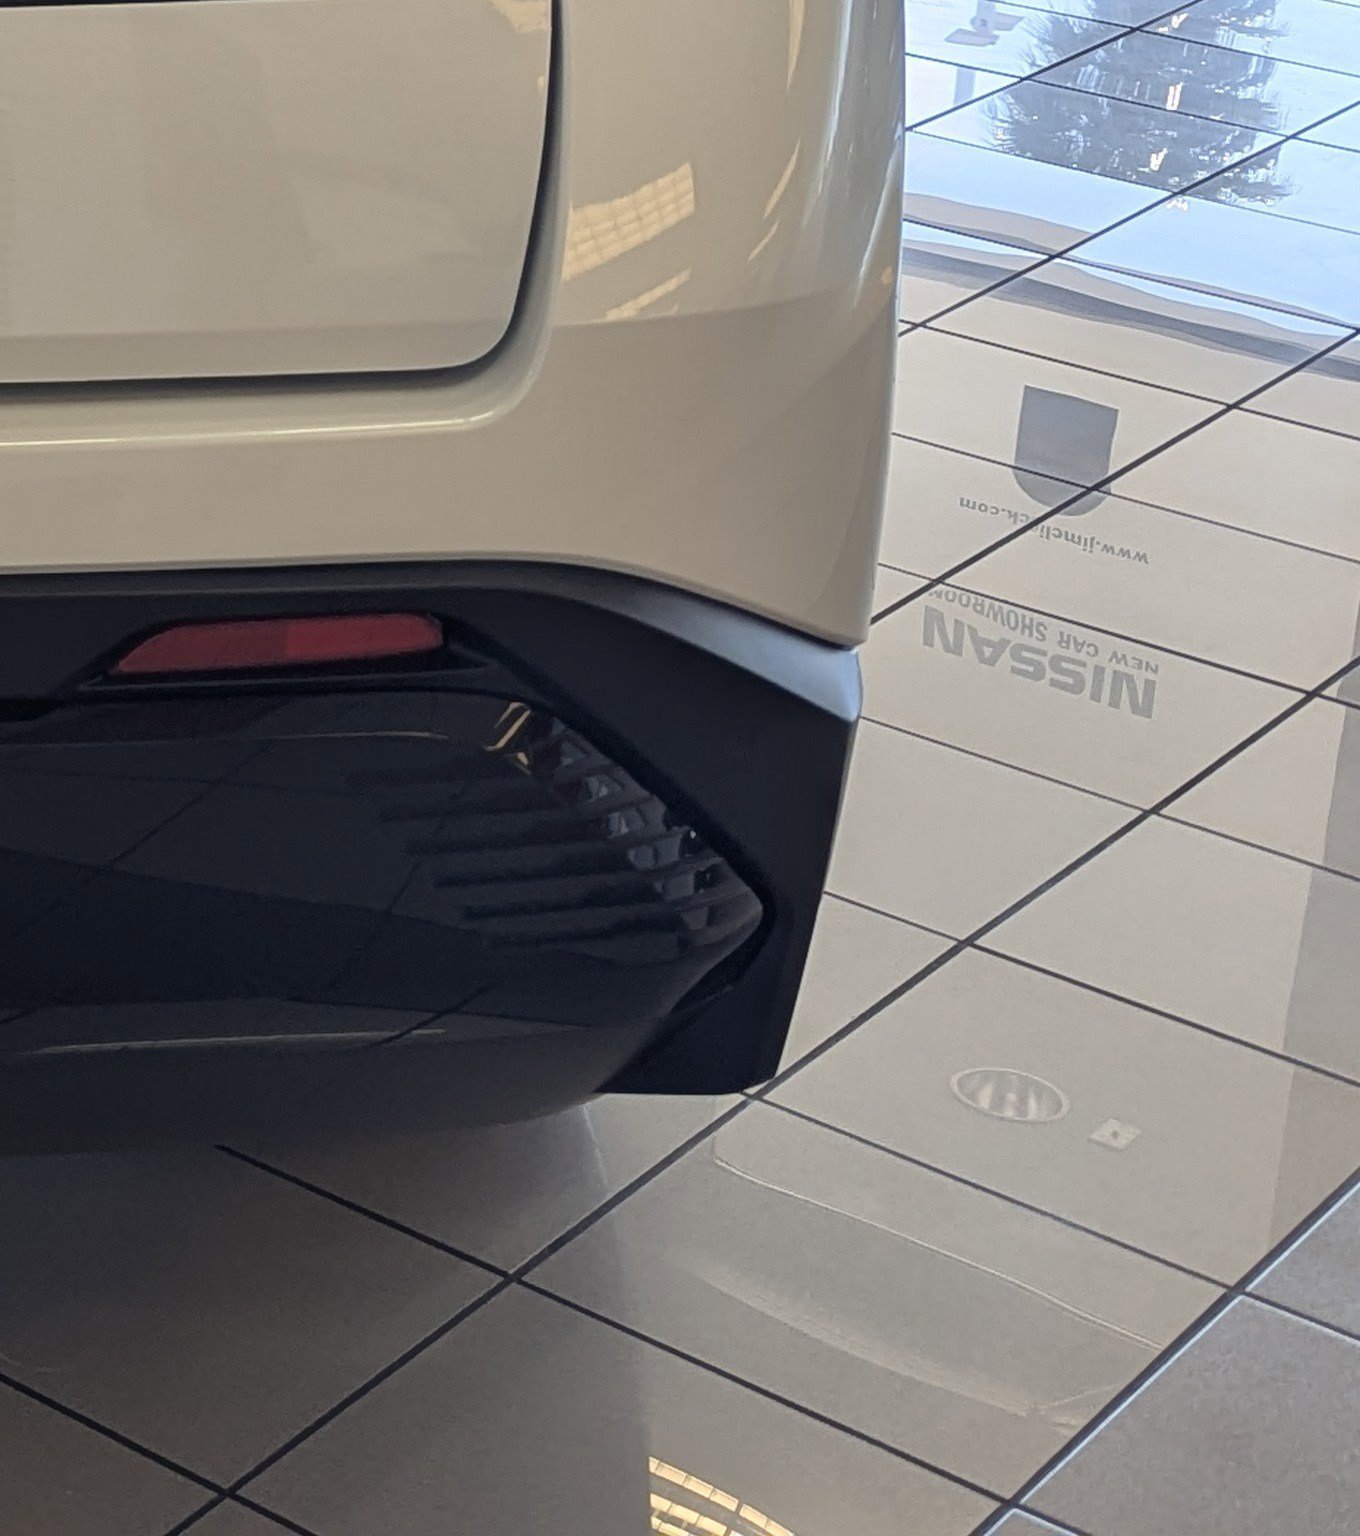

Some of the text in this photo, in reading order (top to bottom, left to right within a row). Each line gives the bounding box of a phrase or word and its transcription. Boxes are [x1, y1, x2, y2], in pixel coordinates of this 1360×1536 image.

[1058, 630, 1099, 657] CAR
[923, 605, 1157, 719] NISSAN
[1108, 650, 1160, 675] NEW
